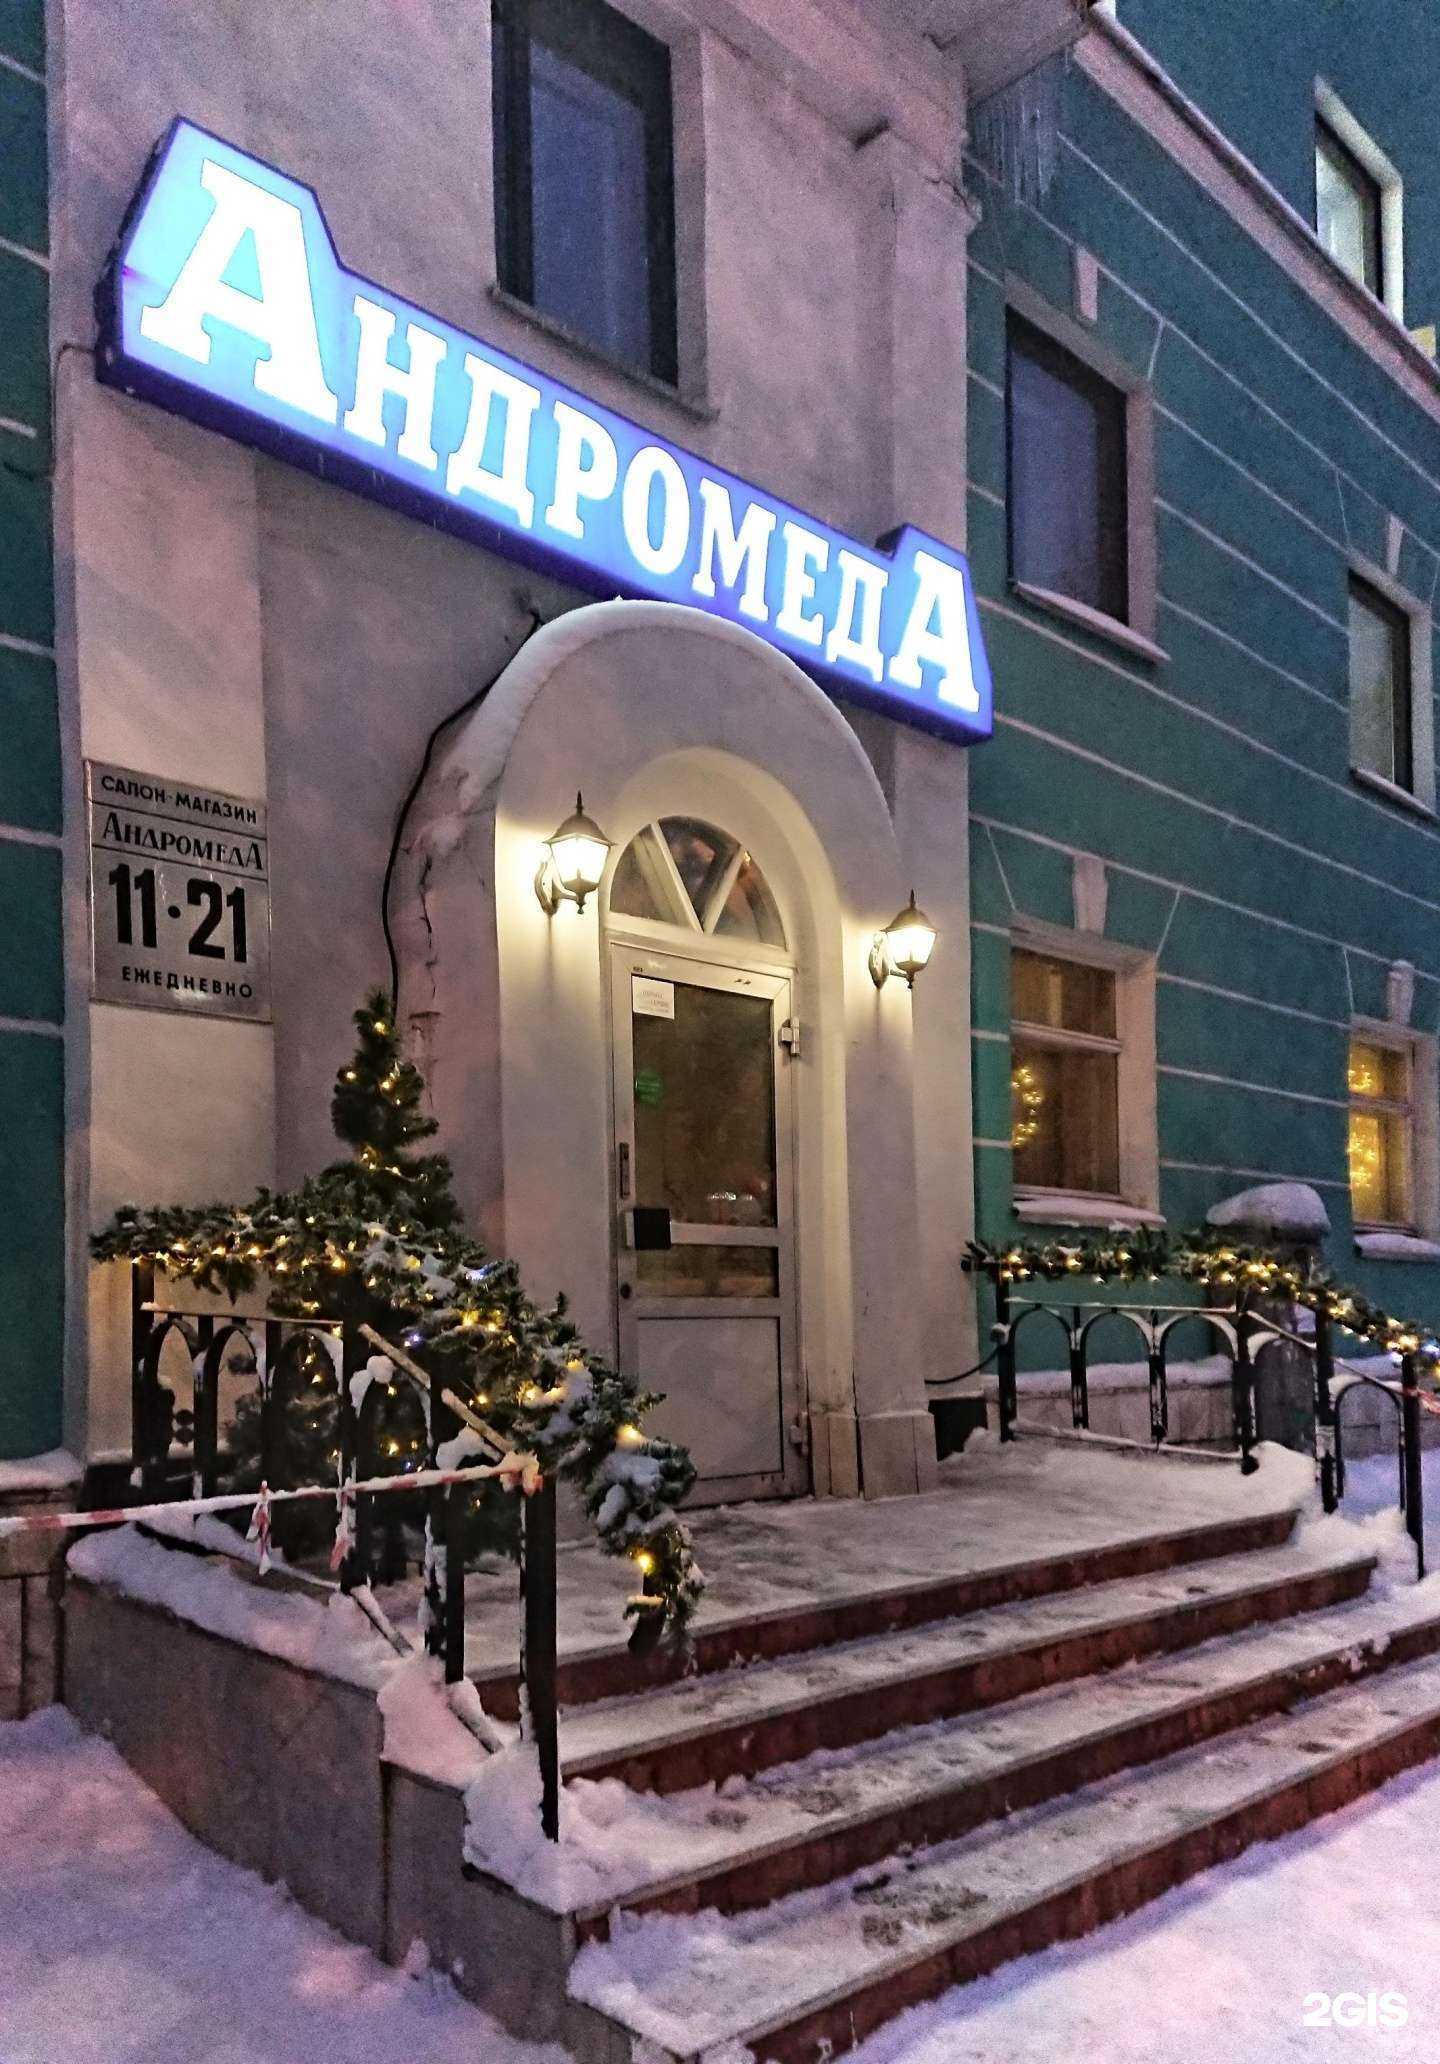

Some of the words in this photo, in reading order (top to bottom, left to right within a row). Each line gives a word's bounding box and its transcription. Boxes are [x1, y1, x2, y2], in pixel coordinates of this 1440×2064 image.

[140, 158, 981, 713] АНДРОМЕДА
[103, 811, 263, 871] АНДРОМЕДА
[122, 965, 253, 999] ЕЖЕДНЕВНО
